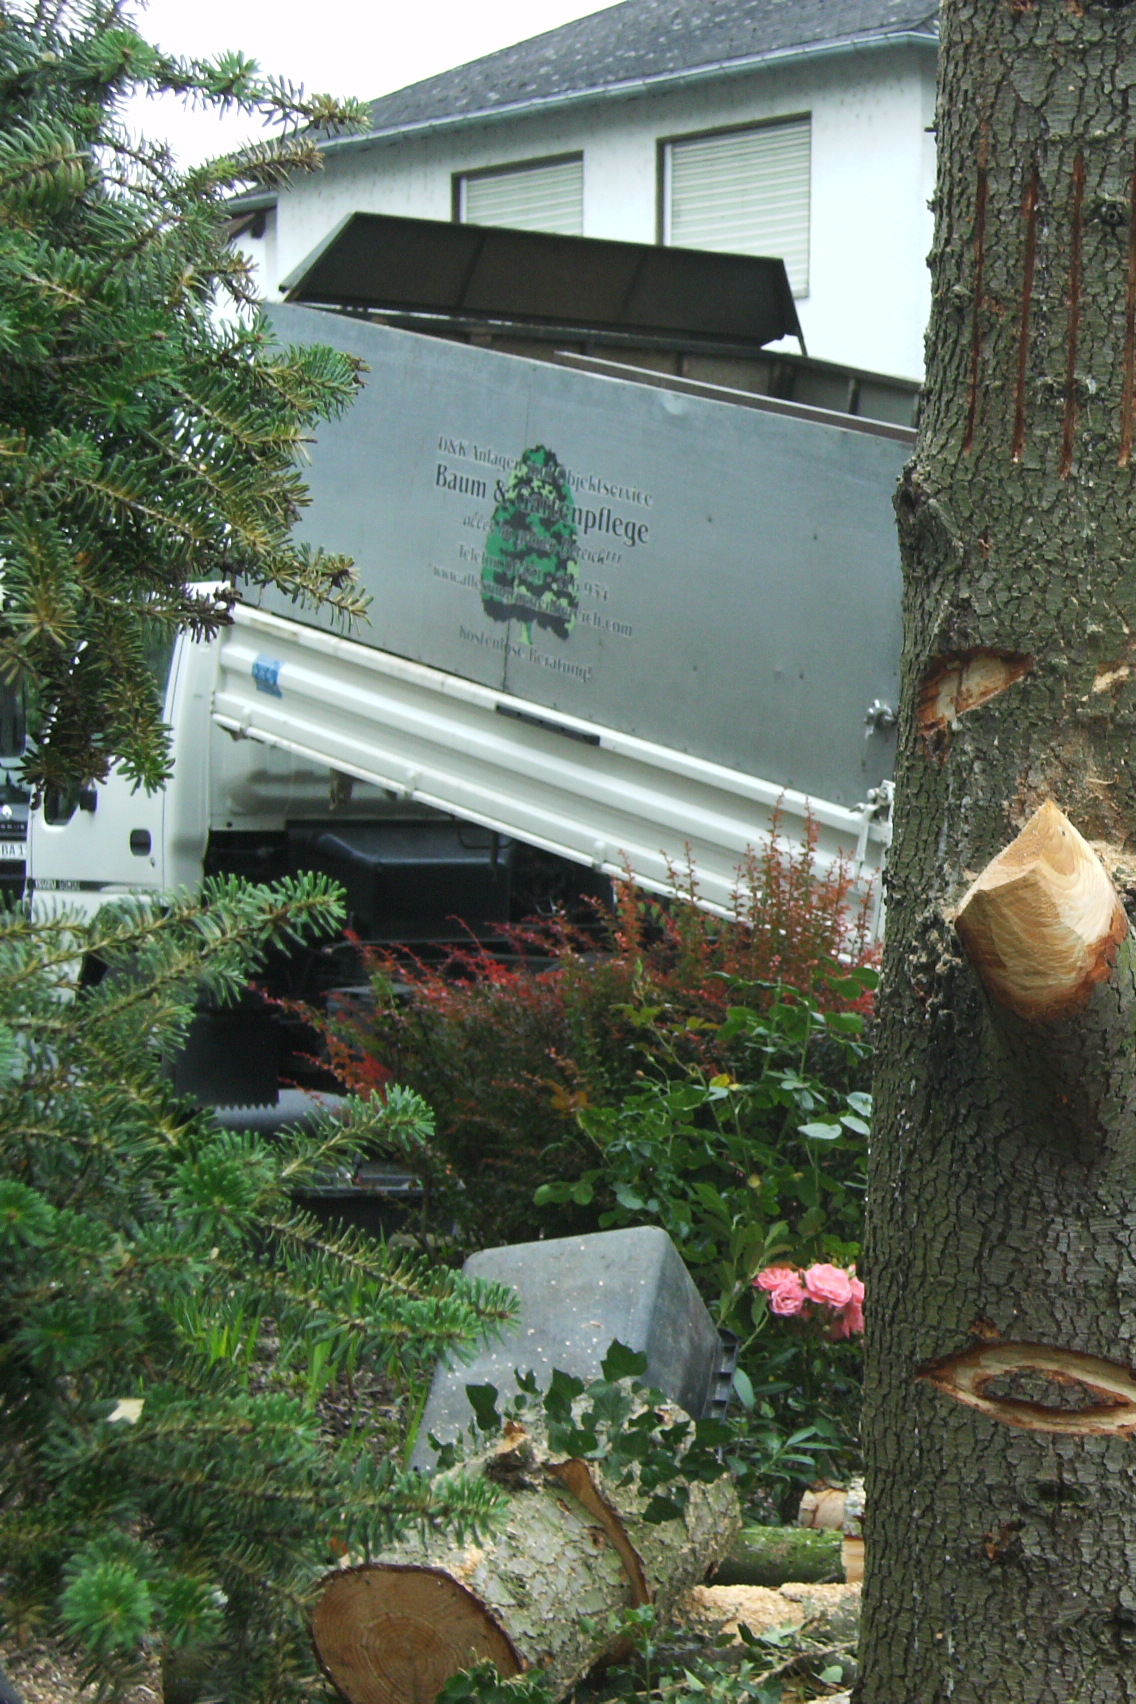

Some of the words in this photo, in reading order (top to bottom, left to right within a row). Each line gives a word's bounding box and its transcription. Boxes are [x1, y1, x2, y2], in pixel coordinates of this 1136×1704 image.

[435, 463, 487, 500] Baum
[493, 480, 508, 504] &
[516, 489, 649, 547] Gartenpflege
